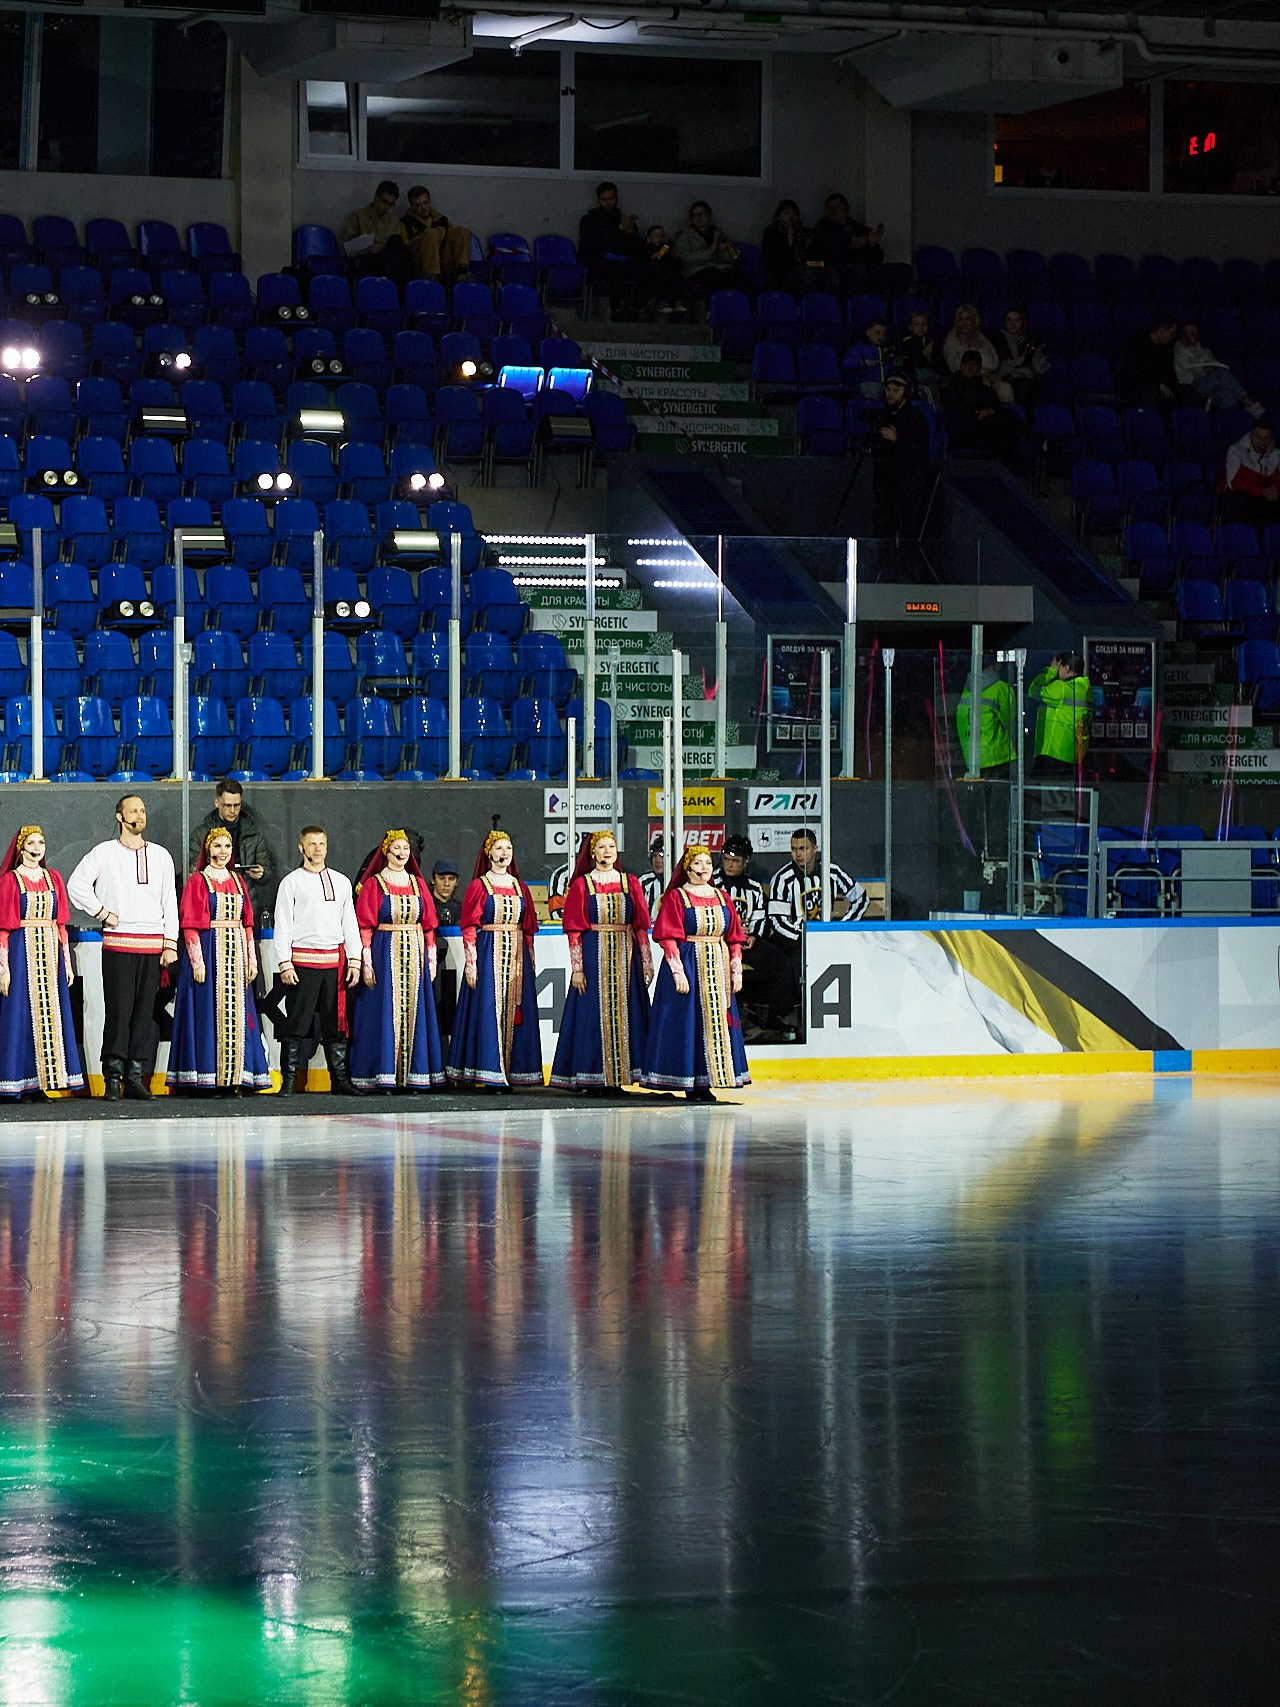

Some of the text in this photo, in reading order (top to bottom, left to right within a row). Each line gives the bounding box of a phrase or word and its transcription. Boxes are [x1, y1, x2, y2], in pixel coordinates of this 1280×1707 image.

[605, 348, 680, 359] ДЛЯ ЧИСТОТЫ
[635, 366, 690, 379] SYNERGETIC
[657, 387, 707, 398] КРАСОТЫ
[662, 402, 717, 415] SYNERGETIC
[540, 595, 610, 606] ДЛЯ КРАСТЫ
[906, 603, 939, 612] ВЫХОД
[569, 615, 628, 629] SYNRGETIC
[567, 639, 644, 649] ДЛ ДОРОВЬЯ
[625, 682, 673, 692] ЧИСТОТЫ
[630, 705, 691, 718] SYNERGIC
[1172, 709, 1229, 721] SYNERGETIC
[634, 728, 705, 739] ДЛЯ КОТЫ
[1180, 734, 1246, 744] ДЛЯ КРАСОТЫ
[1210, 755, 1268, 767] SYNERGETIC
[561, 802, 619, 811] Рстелеко
[754, 793, 818, 810] PARI
[650, 829, 723, 846] FBET
